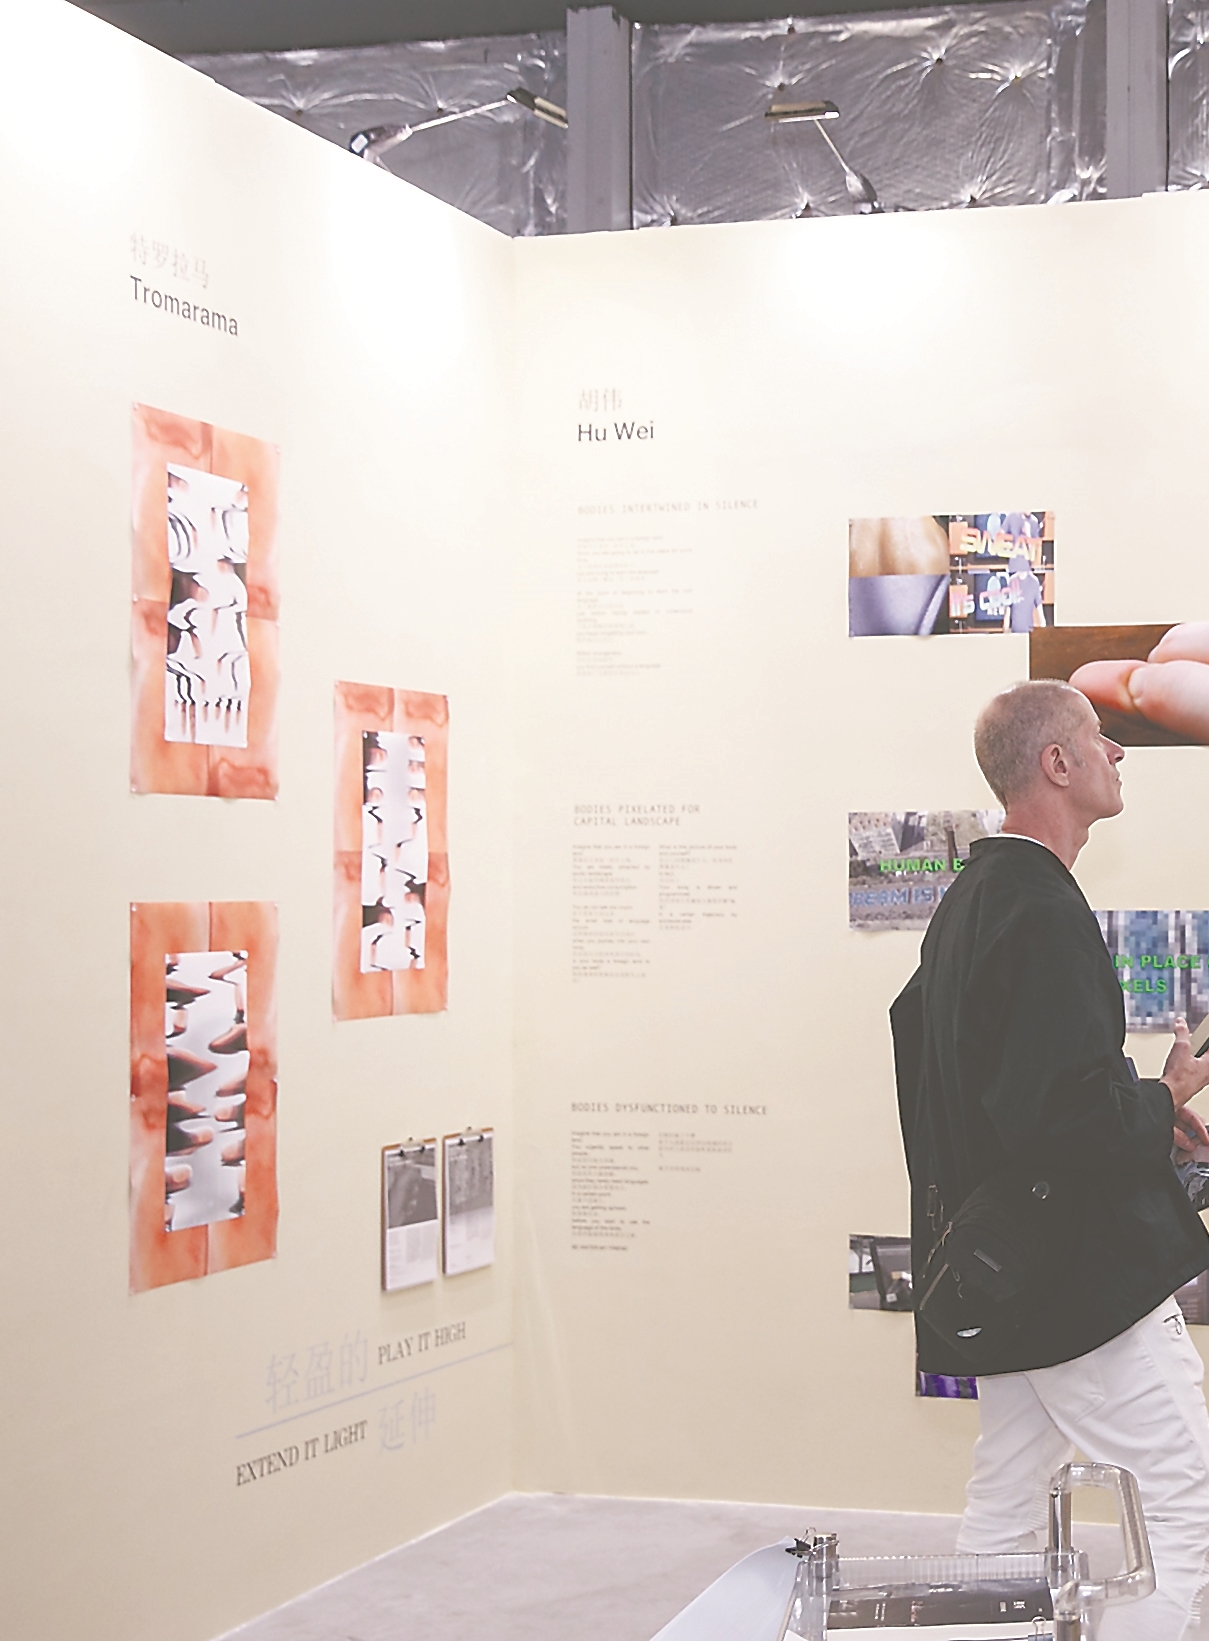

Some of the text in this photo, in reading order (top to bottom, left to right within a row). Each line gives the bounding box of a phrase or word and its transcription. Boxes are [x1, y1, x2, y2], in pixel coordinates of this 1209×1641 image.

[129, 231, 209, 289] 特罗拉马
[129, 274, 239, 336] Tromarama
[578, 387, 623, 413] 胡伟
[577, 420, 655, 442] Hu Wei
[715, 498, 759, 511] SILENCE
[959, 527, 1043, 562] SWEAT
[573, 804, 702, 815] BODIES PIXELATED FOR
[573, 816, 681, 827] CAPITAL LANDSCAPE
[879, 858, 946, 874] HUMAN
[1113, 955, 1134, 969] IN
[1140, 955, 1202, 970] PLACE
[571, 1102, 768, 1116] BODIES DYSFUNCTIONED TO SILENCE
[378, 1321, 467, 1366] PLAY IT HIGH
[265, 1328, 370, 1415] 轻盈的
[378, 1385, 437, 1454] 延伸
[235, 1419, 369, 1488] EXTEND IT LIGHT
